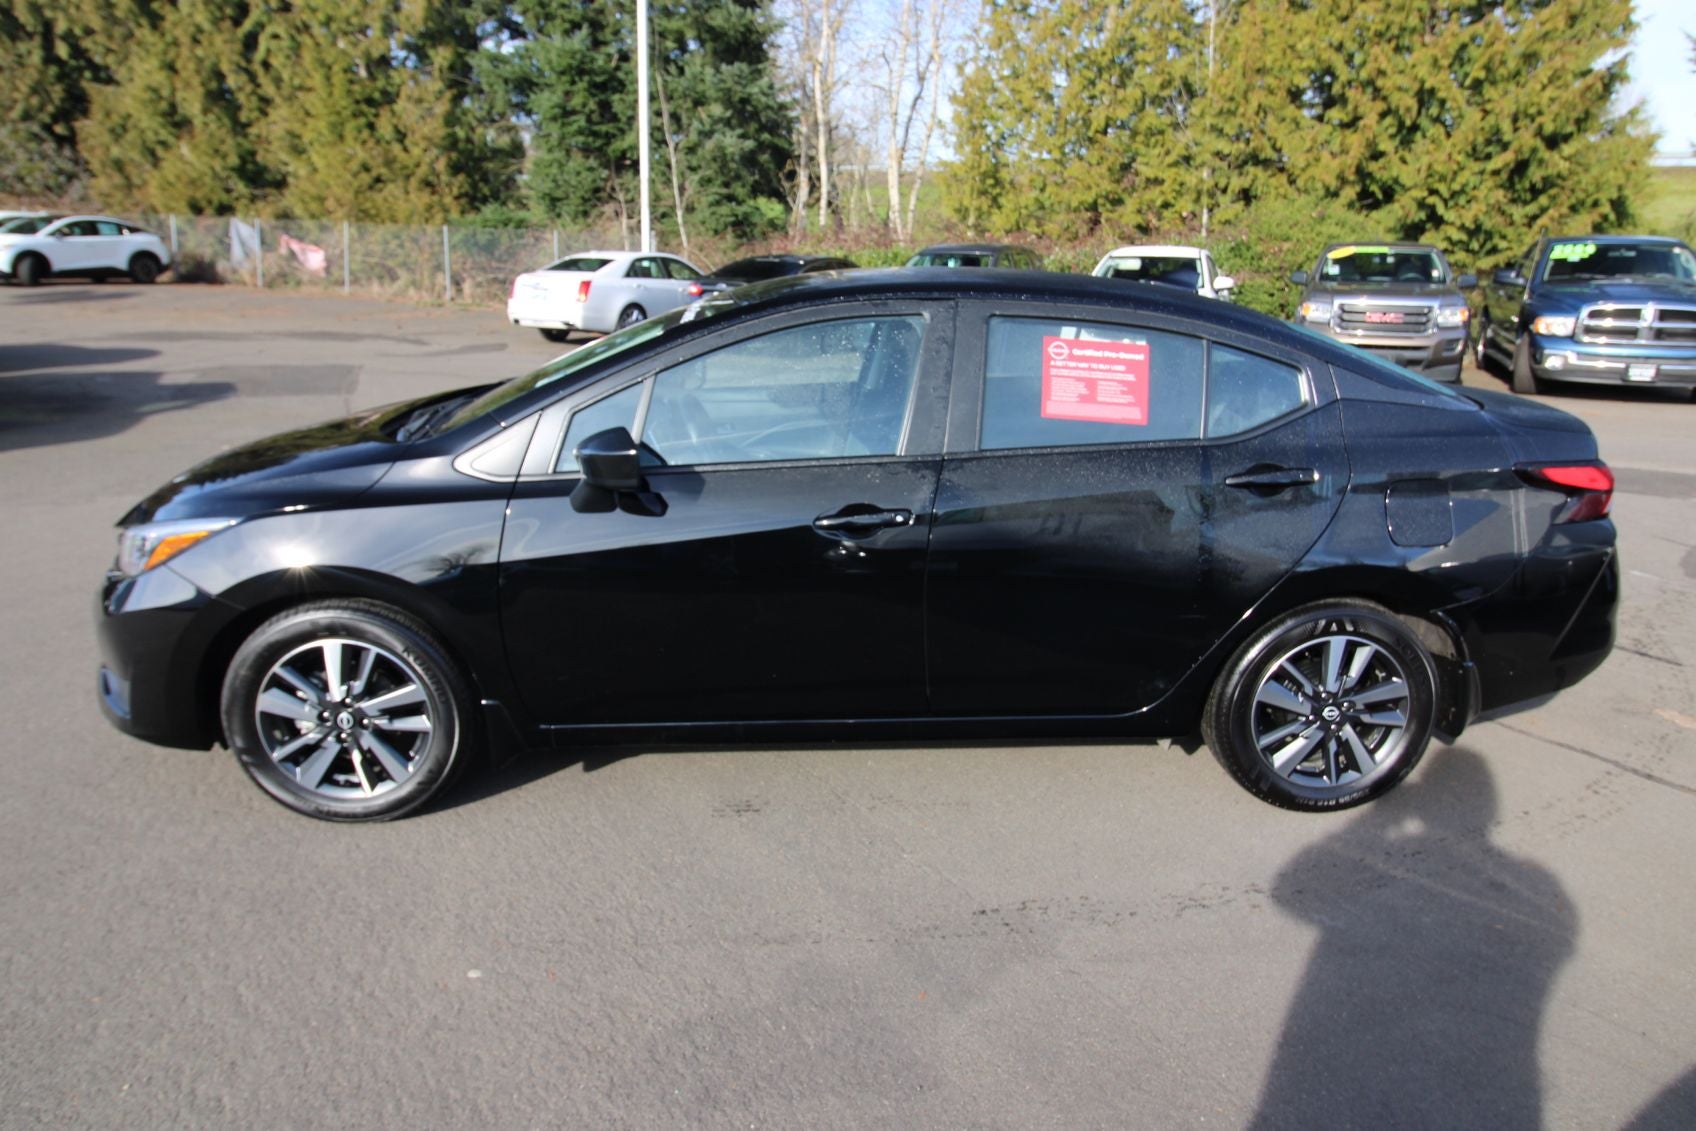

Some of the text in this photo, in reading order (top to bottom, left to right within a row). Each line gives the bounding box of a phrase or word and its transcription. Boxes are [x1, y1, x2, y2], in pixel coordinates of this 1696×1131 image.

[1365, 311, 1404, 323] GMC
[1072, 348, 1103, 357] Certified
[1103, 350, 1144, 360] Pre-Owned
